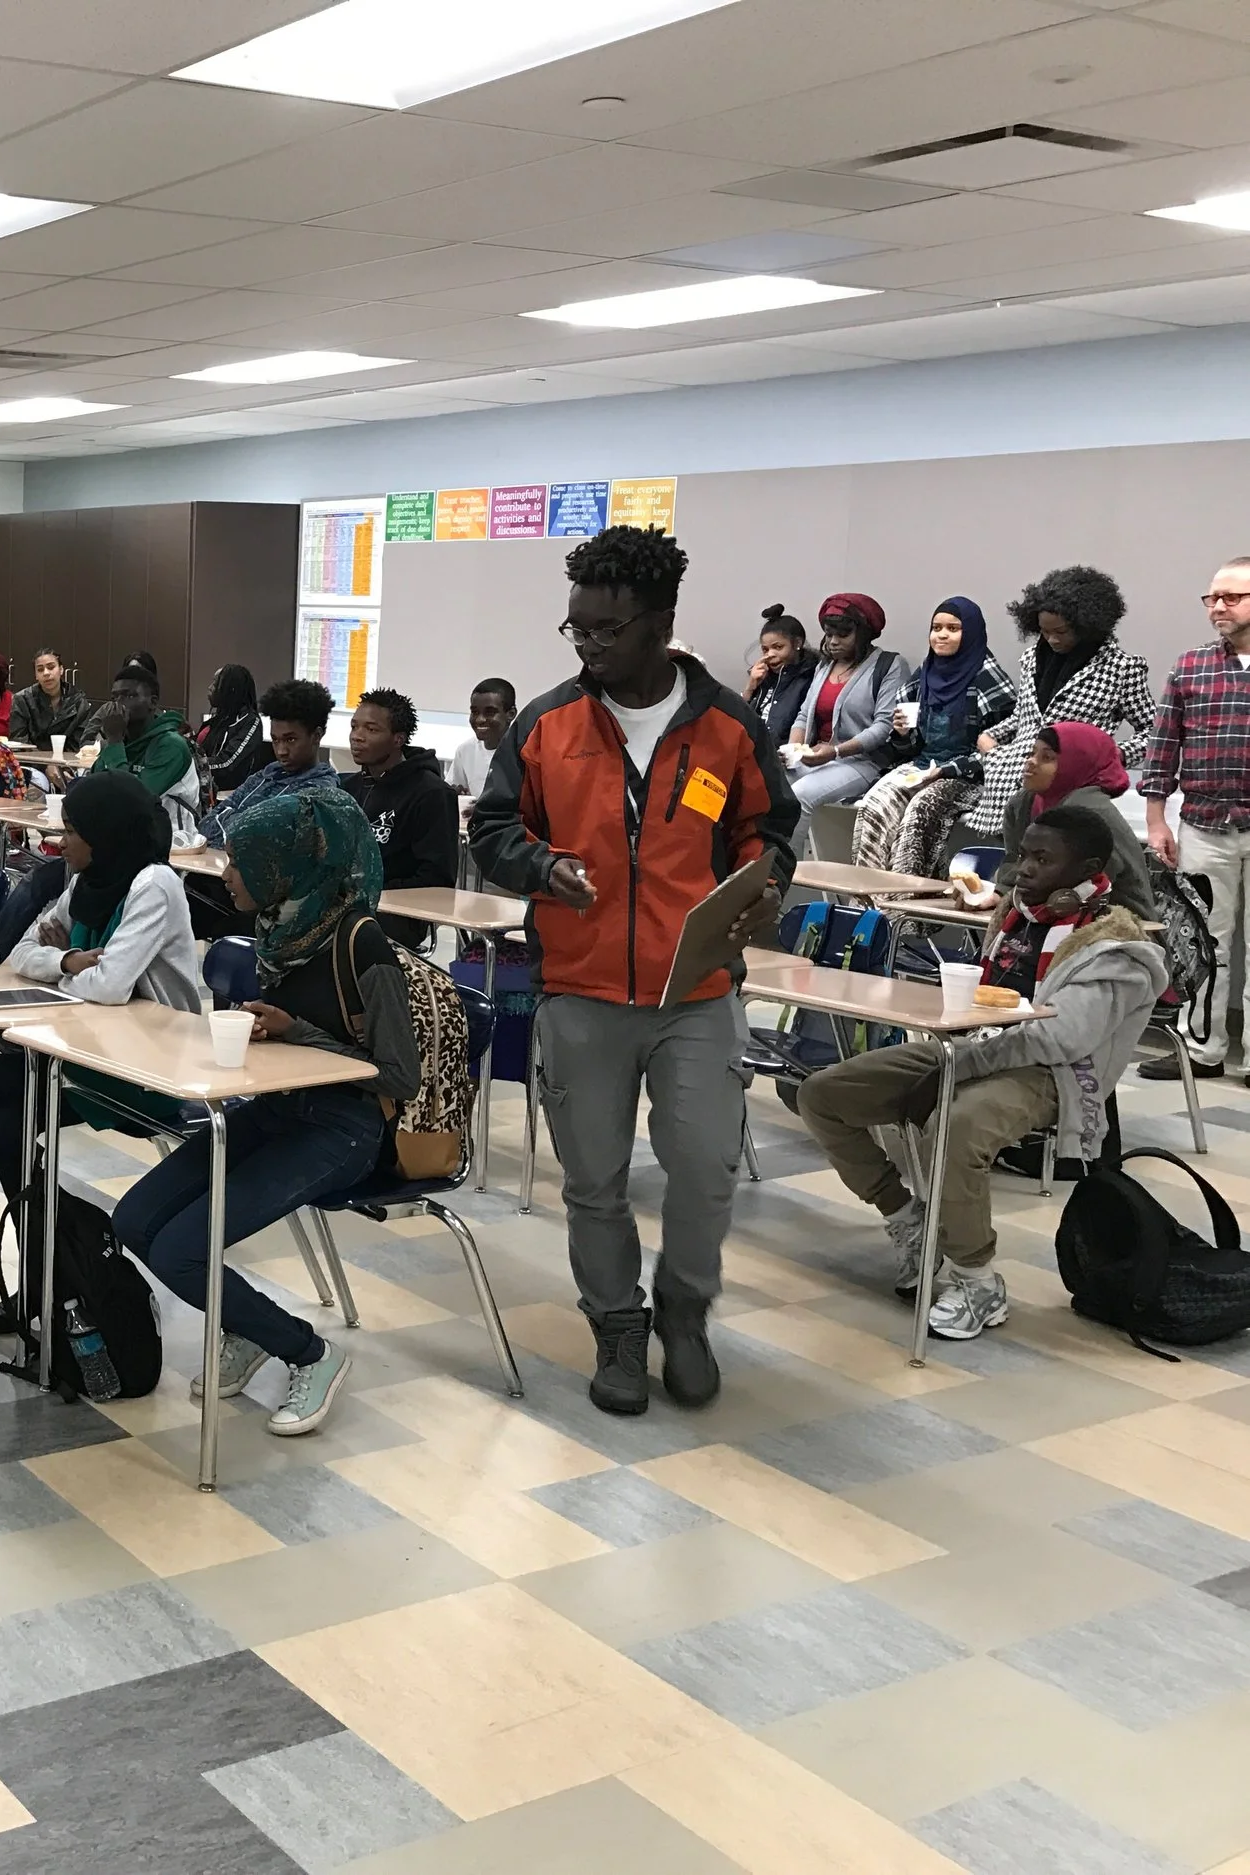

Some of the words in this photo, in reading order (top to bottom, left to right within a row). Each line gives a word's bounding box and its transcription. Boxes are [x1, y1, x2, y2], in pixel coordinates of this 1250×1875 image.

[496, 489, 542, 501] Meaningfully
[637, 486, 671, 496] everyone
[647, 495, 661, 504] and
[494, 501, 531, 512] contribute
[534, 502, 541, 511] to
[494, 513, 525, 524] activities
[528, 512, 541, 522] and
[654, 508, 670, 518] keep
[496, 525, 537, 535] discussions.
